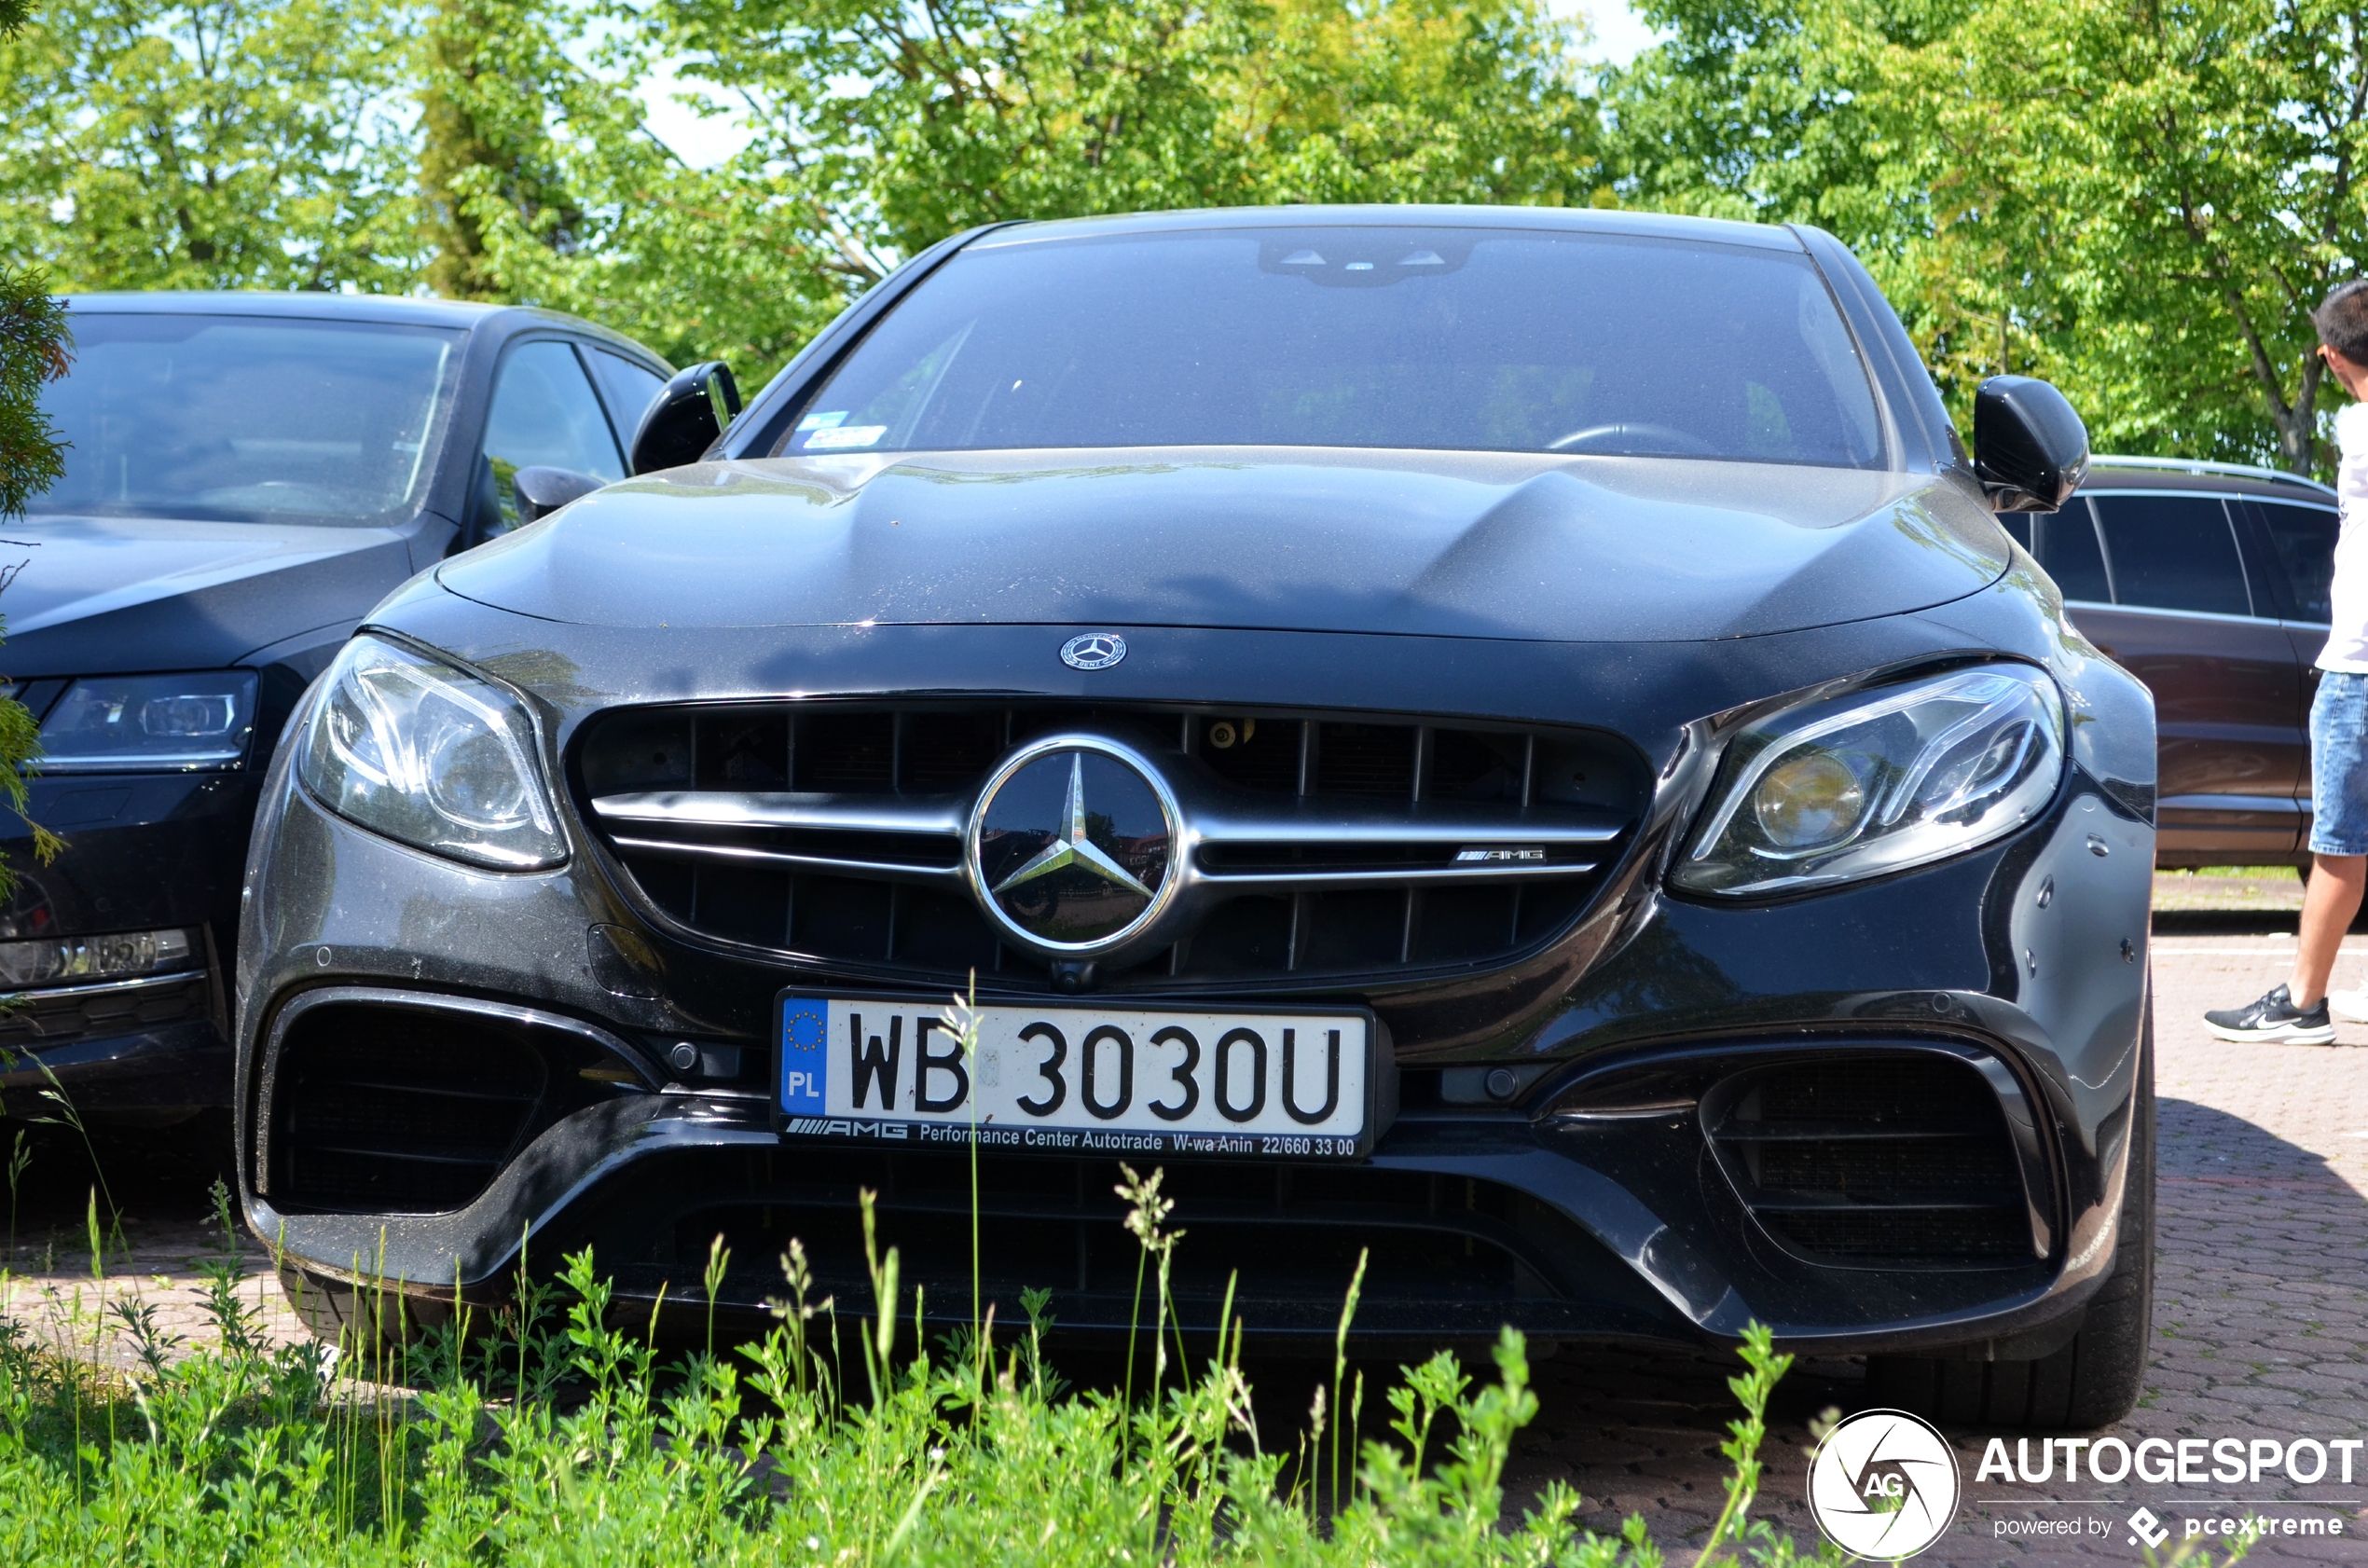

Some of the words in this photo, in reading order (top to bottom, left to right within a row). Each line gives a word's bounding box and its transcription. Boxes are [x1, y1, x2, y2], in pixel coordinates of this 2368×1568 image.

[1484, 849, 1543, 860] AMG
[849, 1012, 971, 1113] WB
[1015, 1021, 1341, 1124] 3030U
[789, 1071, 819, 1098] PL
[824, 1120, 908, 1139] AMG
[920, 1123, 1019, 1145] Performance
[1026, 1128, 1077, 1147] Center
[1081, 1131, 1163, 1149] Autotrade
[1173, 1134, 1215, 1151] W-wa
[1218, 1135, 1253, 1152] Anin
[1261, 1136, 1310, 1154] 22/660
[1315, 1138, 1332, 1155] 33
[1336, 1139, 1355, 1155] 00
